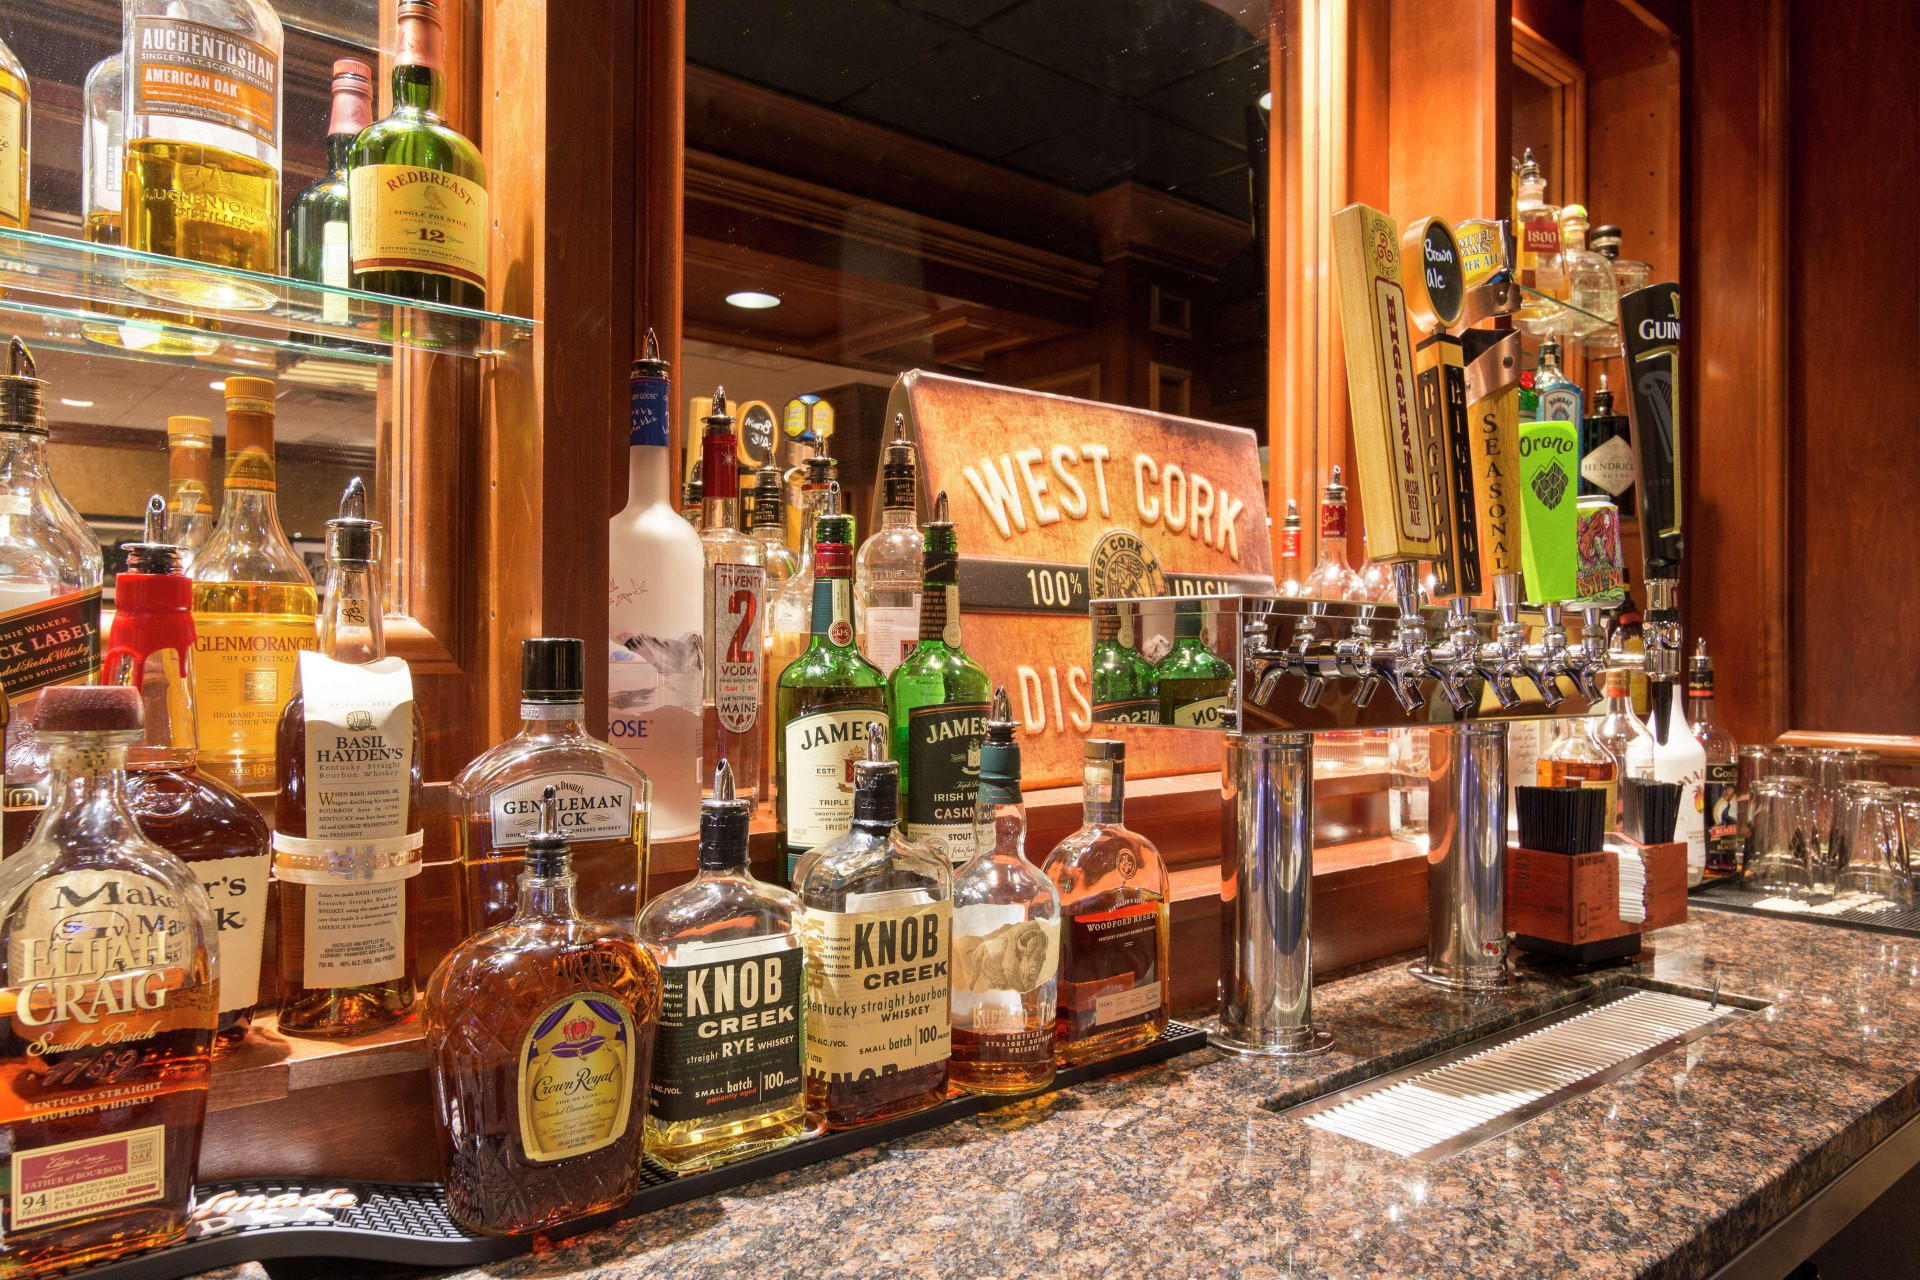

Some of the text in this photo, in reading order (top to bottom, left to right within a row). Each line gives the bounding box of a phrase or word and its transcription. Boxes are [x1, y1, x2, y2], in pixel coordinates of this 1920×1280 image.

[192, 27, 215, 37] TRIPLE
[219, 34, 250, 49] DISTILLED
[142, 28, 274, 83] AUCHENTOSHAN
[142, 52, 273, 92] SINGLE MALT SCOTCH WHISKY
[145, 68, 238, 98] AMERICAN OAK
[386, 171, 474, 206] REDBREAST
[447, 217, 467, 227] STILL
[419, 228, 446, 243] 12
[1527, 231, 1557, 243] 1800
[1424, 239, 1453, 263] Brown
[1484, 254, 1500, 266] ALE
[1386, 293, 1415, 476] HIGGINS
[1519, 435, 1574, 457] Orono
[1404, 478, 1420, 495] IRISH
[1422, 382, 1450, 588] BIGELOW
[1451, 379, 1476, 586] BIGELOW
[1482, 412, 1510, 571] SEASONAL
[963, 444, 1244, 562] WEST CORK
[1408, 495, 1420, 511] RED
[1410, 511, 1422, 527] ALE
[1095, 536, 1143, 596] WEST CORK
[721, 575, 762, 589] TWENTY
[1027, 569, 1083, 607] 100%
[25, 617, 68, 633] WALKER
[726, 589, 757, 663] 2
[30, 623, 96, 650] LABEL
[194, 636, 313, 651] GLENMORANGIE
[20, 643, 90, 671] Scotch Whisky
[19, 674, 33, 682] AND
[36, 665, 67, 677] BOTTLED
[721, 665, 758, 677] VODKA
[721, 702, 756, 713] MAINE
[1017, 665, 1092, 735] DIS
[608, 720, 648, 738] OSE
[336, 736, 386, 749] BASIL
[317, 748, 403, 762] HAYDEN'S
[367, 762, 400, 770] Straight
[14, 792, 33, 807] 12
[934, 793, 964, 802] IRISH
[948, 833, 972, 841] STOUT
[1087, 918, 1131, 933] WOODFORD
[854, 913, 938, 970] KNOB
[1098, 934, 1116, 942] KENTUCKY
[19, 930, 170, 983] ELIJAH
[863, 960, 947, 991] CREEK
[16, 971, 168, 1026] CRAIG
[687, 957, 782, 1018] KNOB
[807, 986, 947, 1019] kentucky straight bourbon
[881, 1004, 930, 1023] WHISKEY
[698, 1005, 794, 1038] CREEK
[26, 1020, 162, 1057] Small Batch
[859, 1026, 949, 1055] SMALL batch 100 PROOF
[986, 1033, 1053, 1047] STRAIGHT BOURBON
[1007, 1031, 1044, 1041] KENTUCKY
[686, 1035, 795, 1065] straight RYE WHISKEY
[810, 1053, 822, 1063] LITER
[1008, 1045, 1040, 1053] WHISKEY
[42, 1049, 139, 1087] 1789
[533, 1064, 620, 1102] Crown Royal
[695, 1071, 799, 1098] SMALL batch 100 PROOF
[24, 1081, 163, 1113] KENTUCKY STRAIGHT
[706, 1088, 757, 1105] patiently aged
[31, 1095, 155, 1124] BOURBON WHISKEY
[537, 1108, 564, 1121] Blended
[566, 1103, 594, 1113] Canadian
[131, 1142, 153, 1150] FIRST
[24, 1164, 124, 1190] FATHER of BOURBON
[54, 1187, 76, 1195] MADE
[87, 1182, 104, 1190] TRUE
[105, 1176, 127, 1185] SMALL
[128, 1170, 158, 1181] BATCHES
[65, 1188, 101, 1200] BALANCE
[108, 1176, 158, 1190] SMOOTHNESS
[22, 1193, 48, 1210] 94
[54, 1189, 126, 1210] 47% ALC VOL
[22, 1206, 49, 1216] PROOF
